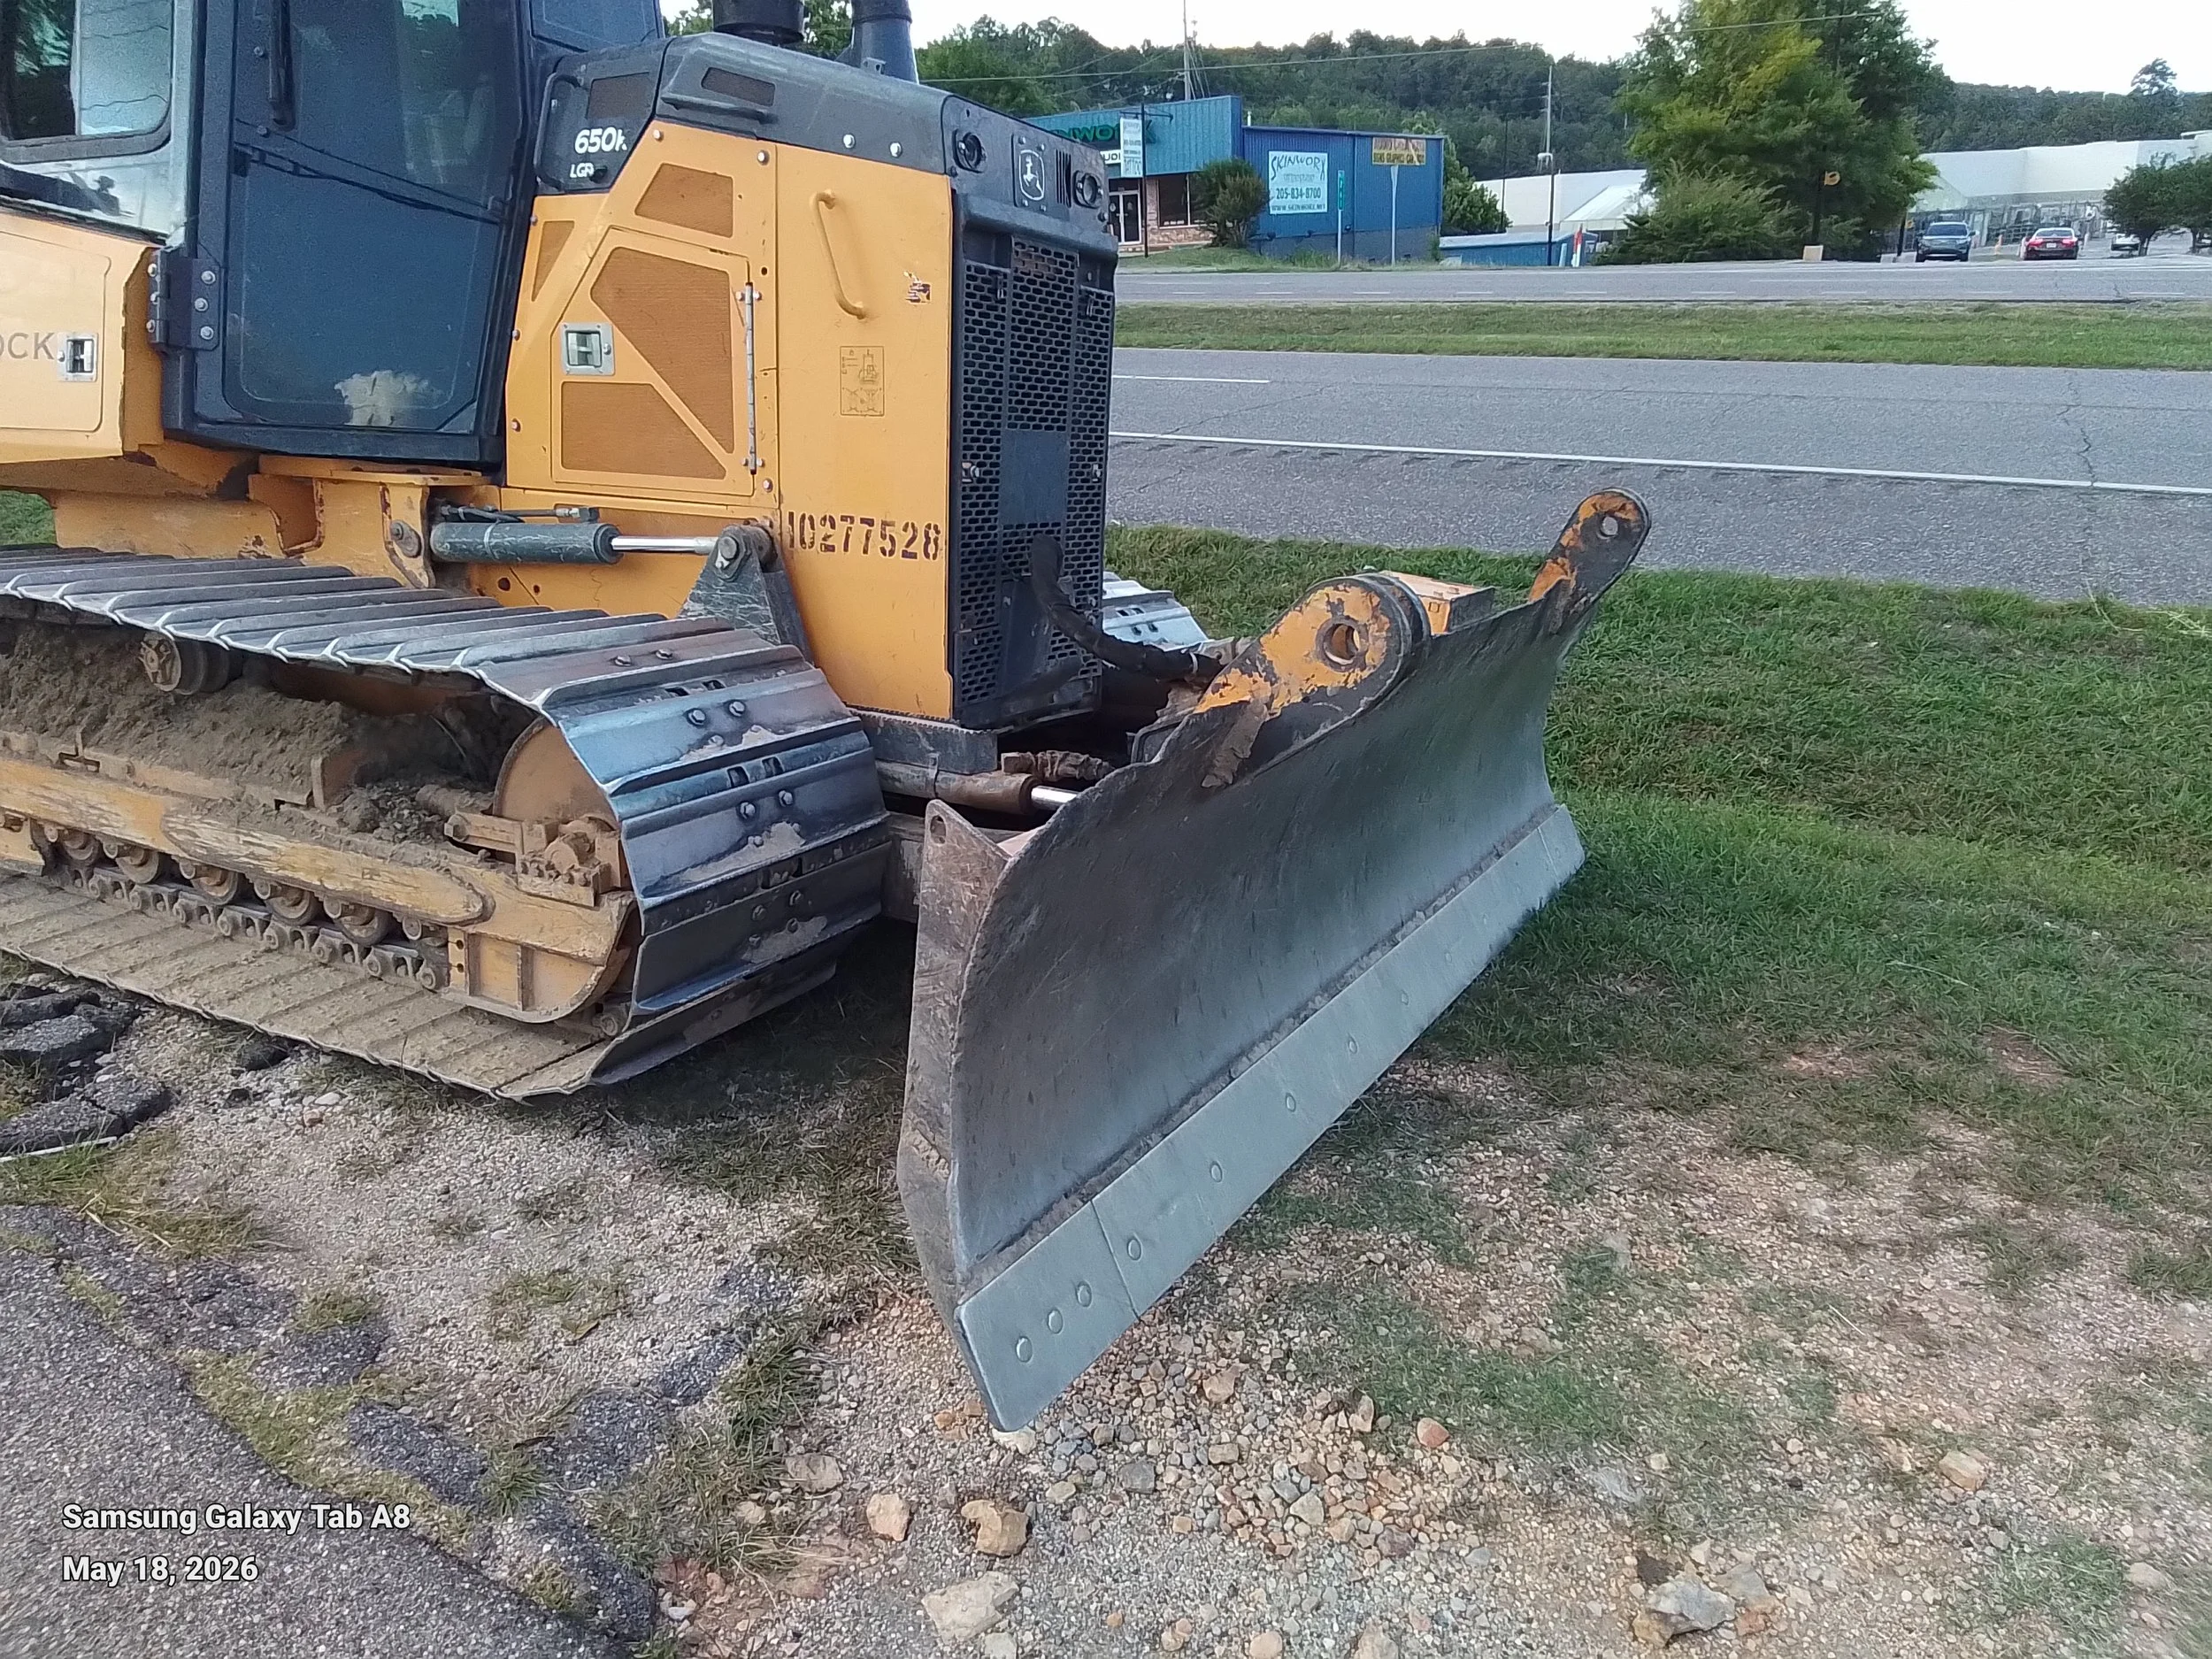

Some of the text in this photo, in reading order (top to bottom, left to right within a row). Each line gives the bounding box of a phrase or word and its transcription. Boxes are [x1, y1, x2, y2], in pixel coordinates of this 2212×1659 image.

[1271, 154, 1326, 181] SKINWORX
[1276, 187, 1322, 200] 205-834-8700
[0, 331, 55, 360] CK
[787, 511, 941, 562] 10277528
